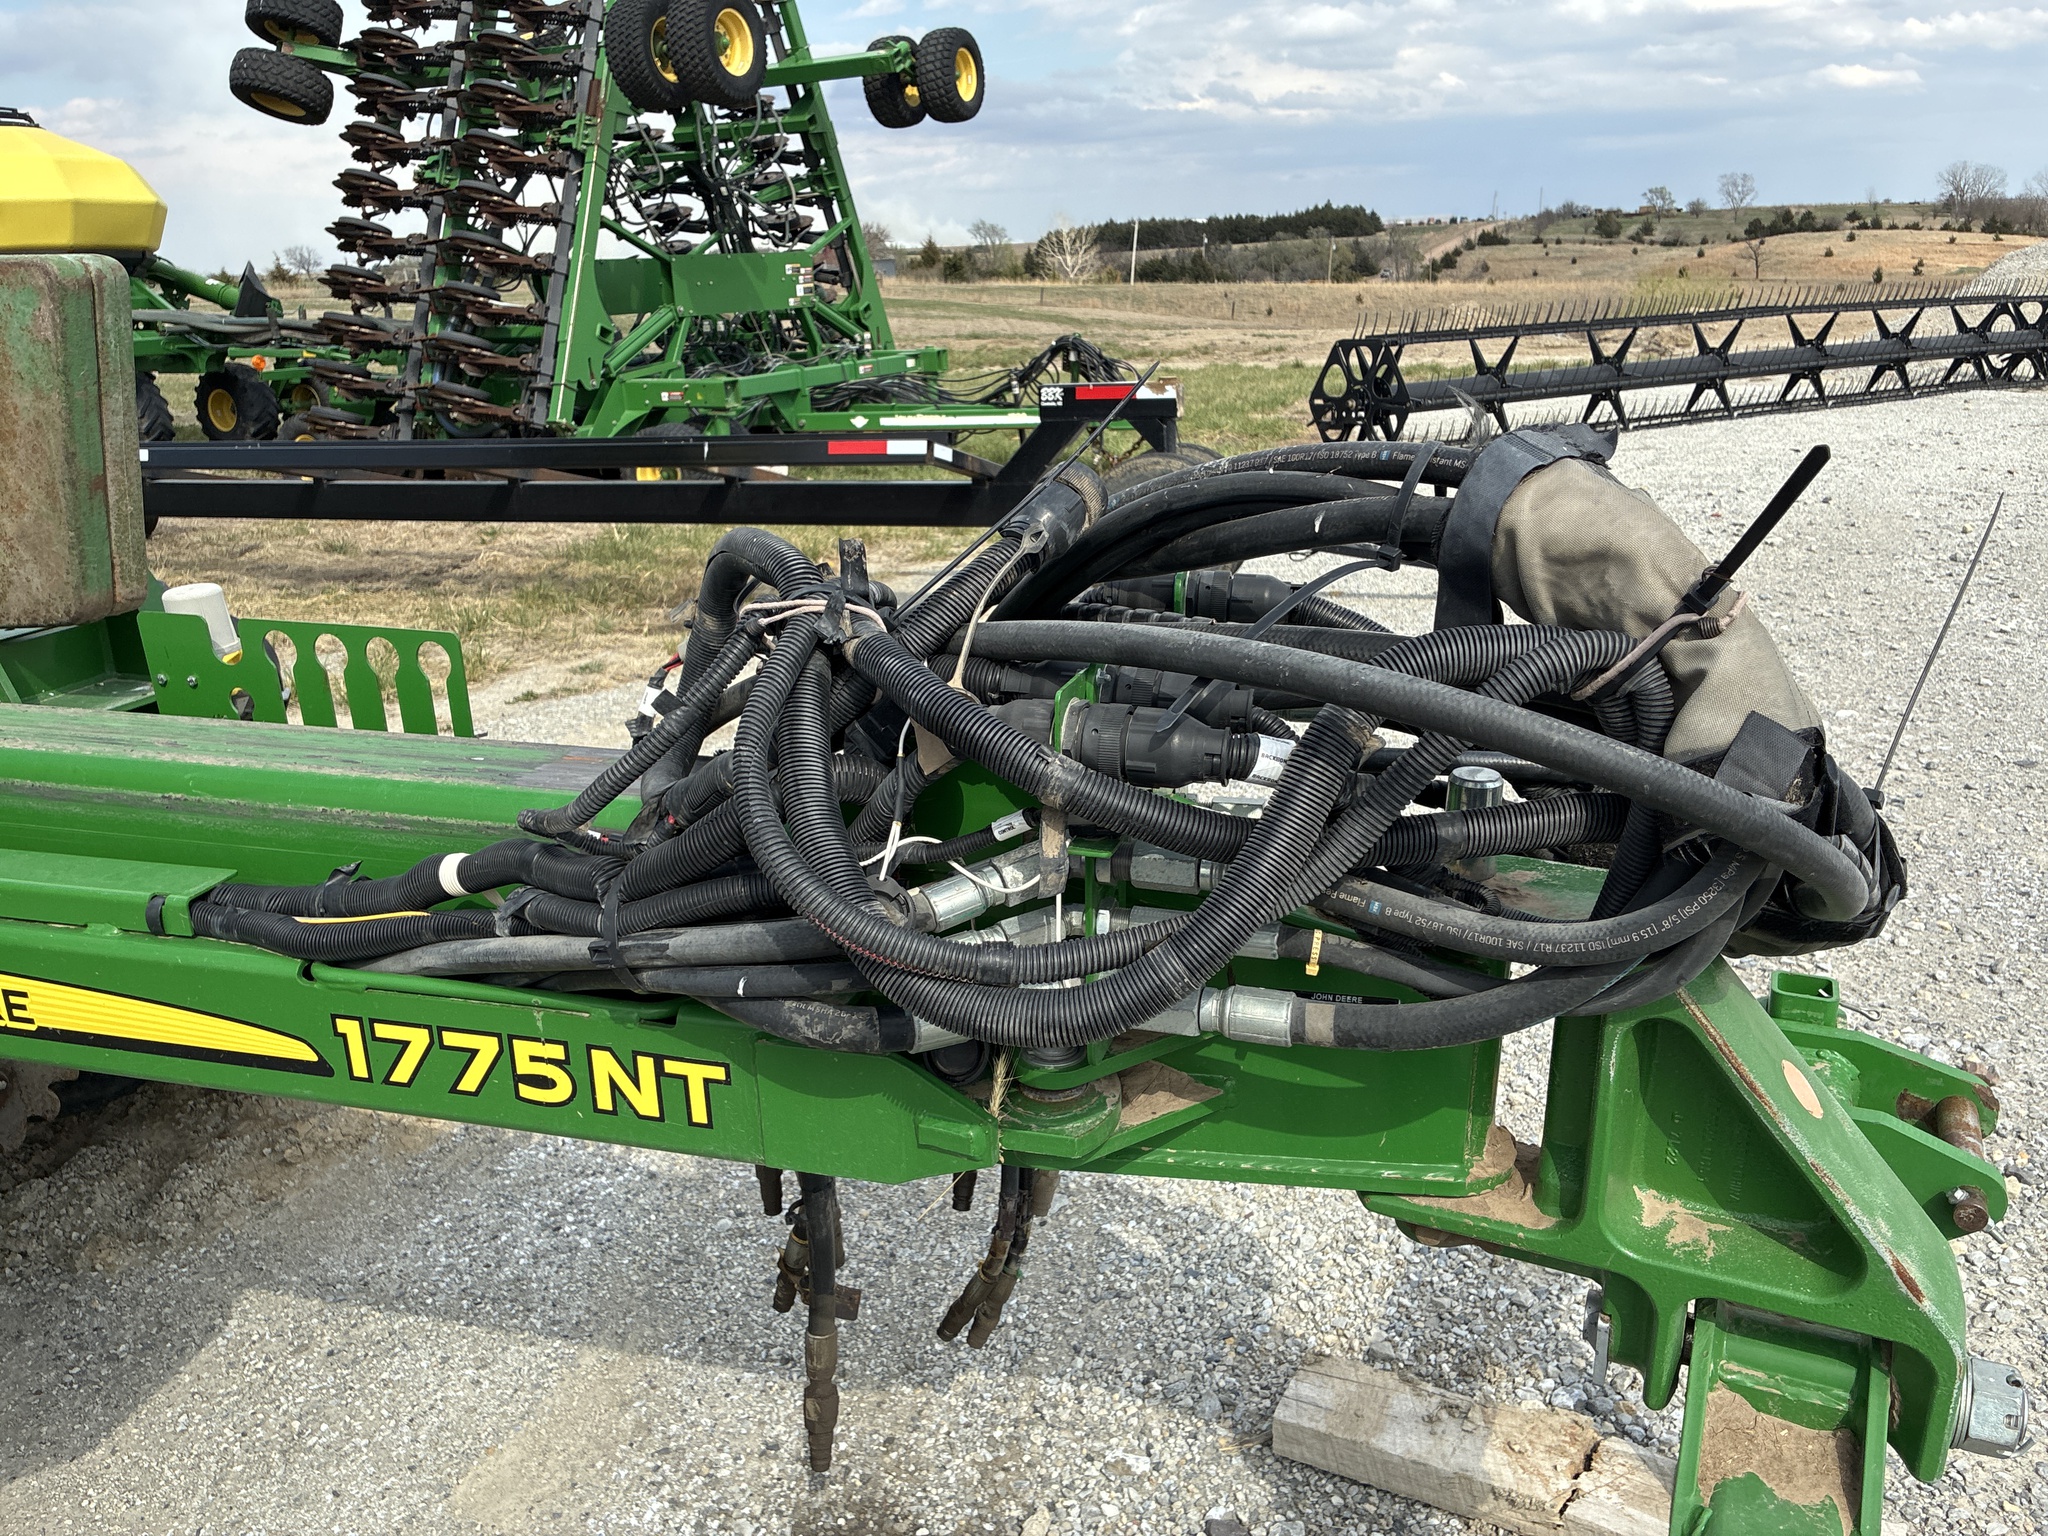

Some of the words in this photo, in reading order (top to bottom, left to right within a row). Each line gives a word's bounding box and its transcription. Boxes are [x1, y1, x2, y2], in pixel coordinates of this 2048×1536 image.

[1331, 450, 1354, 460] 18752
[1392, 451, 1416, 461] Flame
[1453, 459, 1469, 470] MS
[1720, 861, 1741, 881] MPa
[1338, 891, 1367, 908] Flame
[1698, 877, 1726, 906] [3250
[1385, 906, 1392, 917] B
[1393, 908, 1413, 924] Type
[1678, 901, 1701, 920] PSI]
[1414, 916, 1444, 933] 18752
[1632, 923, 1659, 942] [15.9
[1506, 939, 1524, 950] SAE
[1533, 942, 1552, 953] R17
[1555, 942, 1586, 953] 11237
[1588, 940, 1605, 952] ISO
[1310, 993, 1334, 1002] JOHN
[1335, 994, 1363, 1004] DEERE
[330, 1013, 577, 1108] 1775
[586, 1043, 732, 1129] NT
